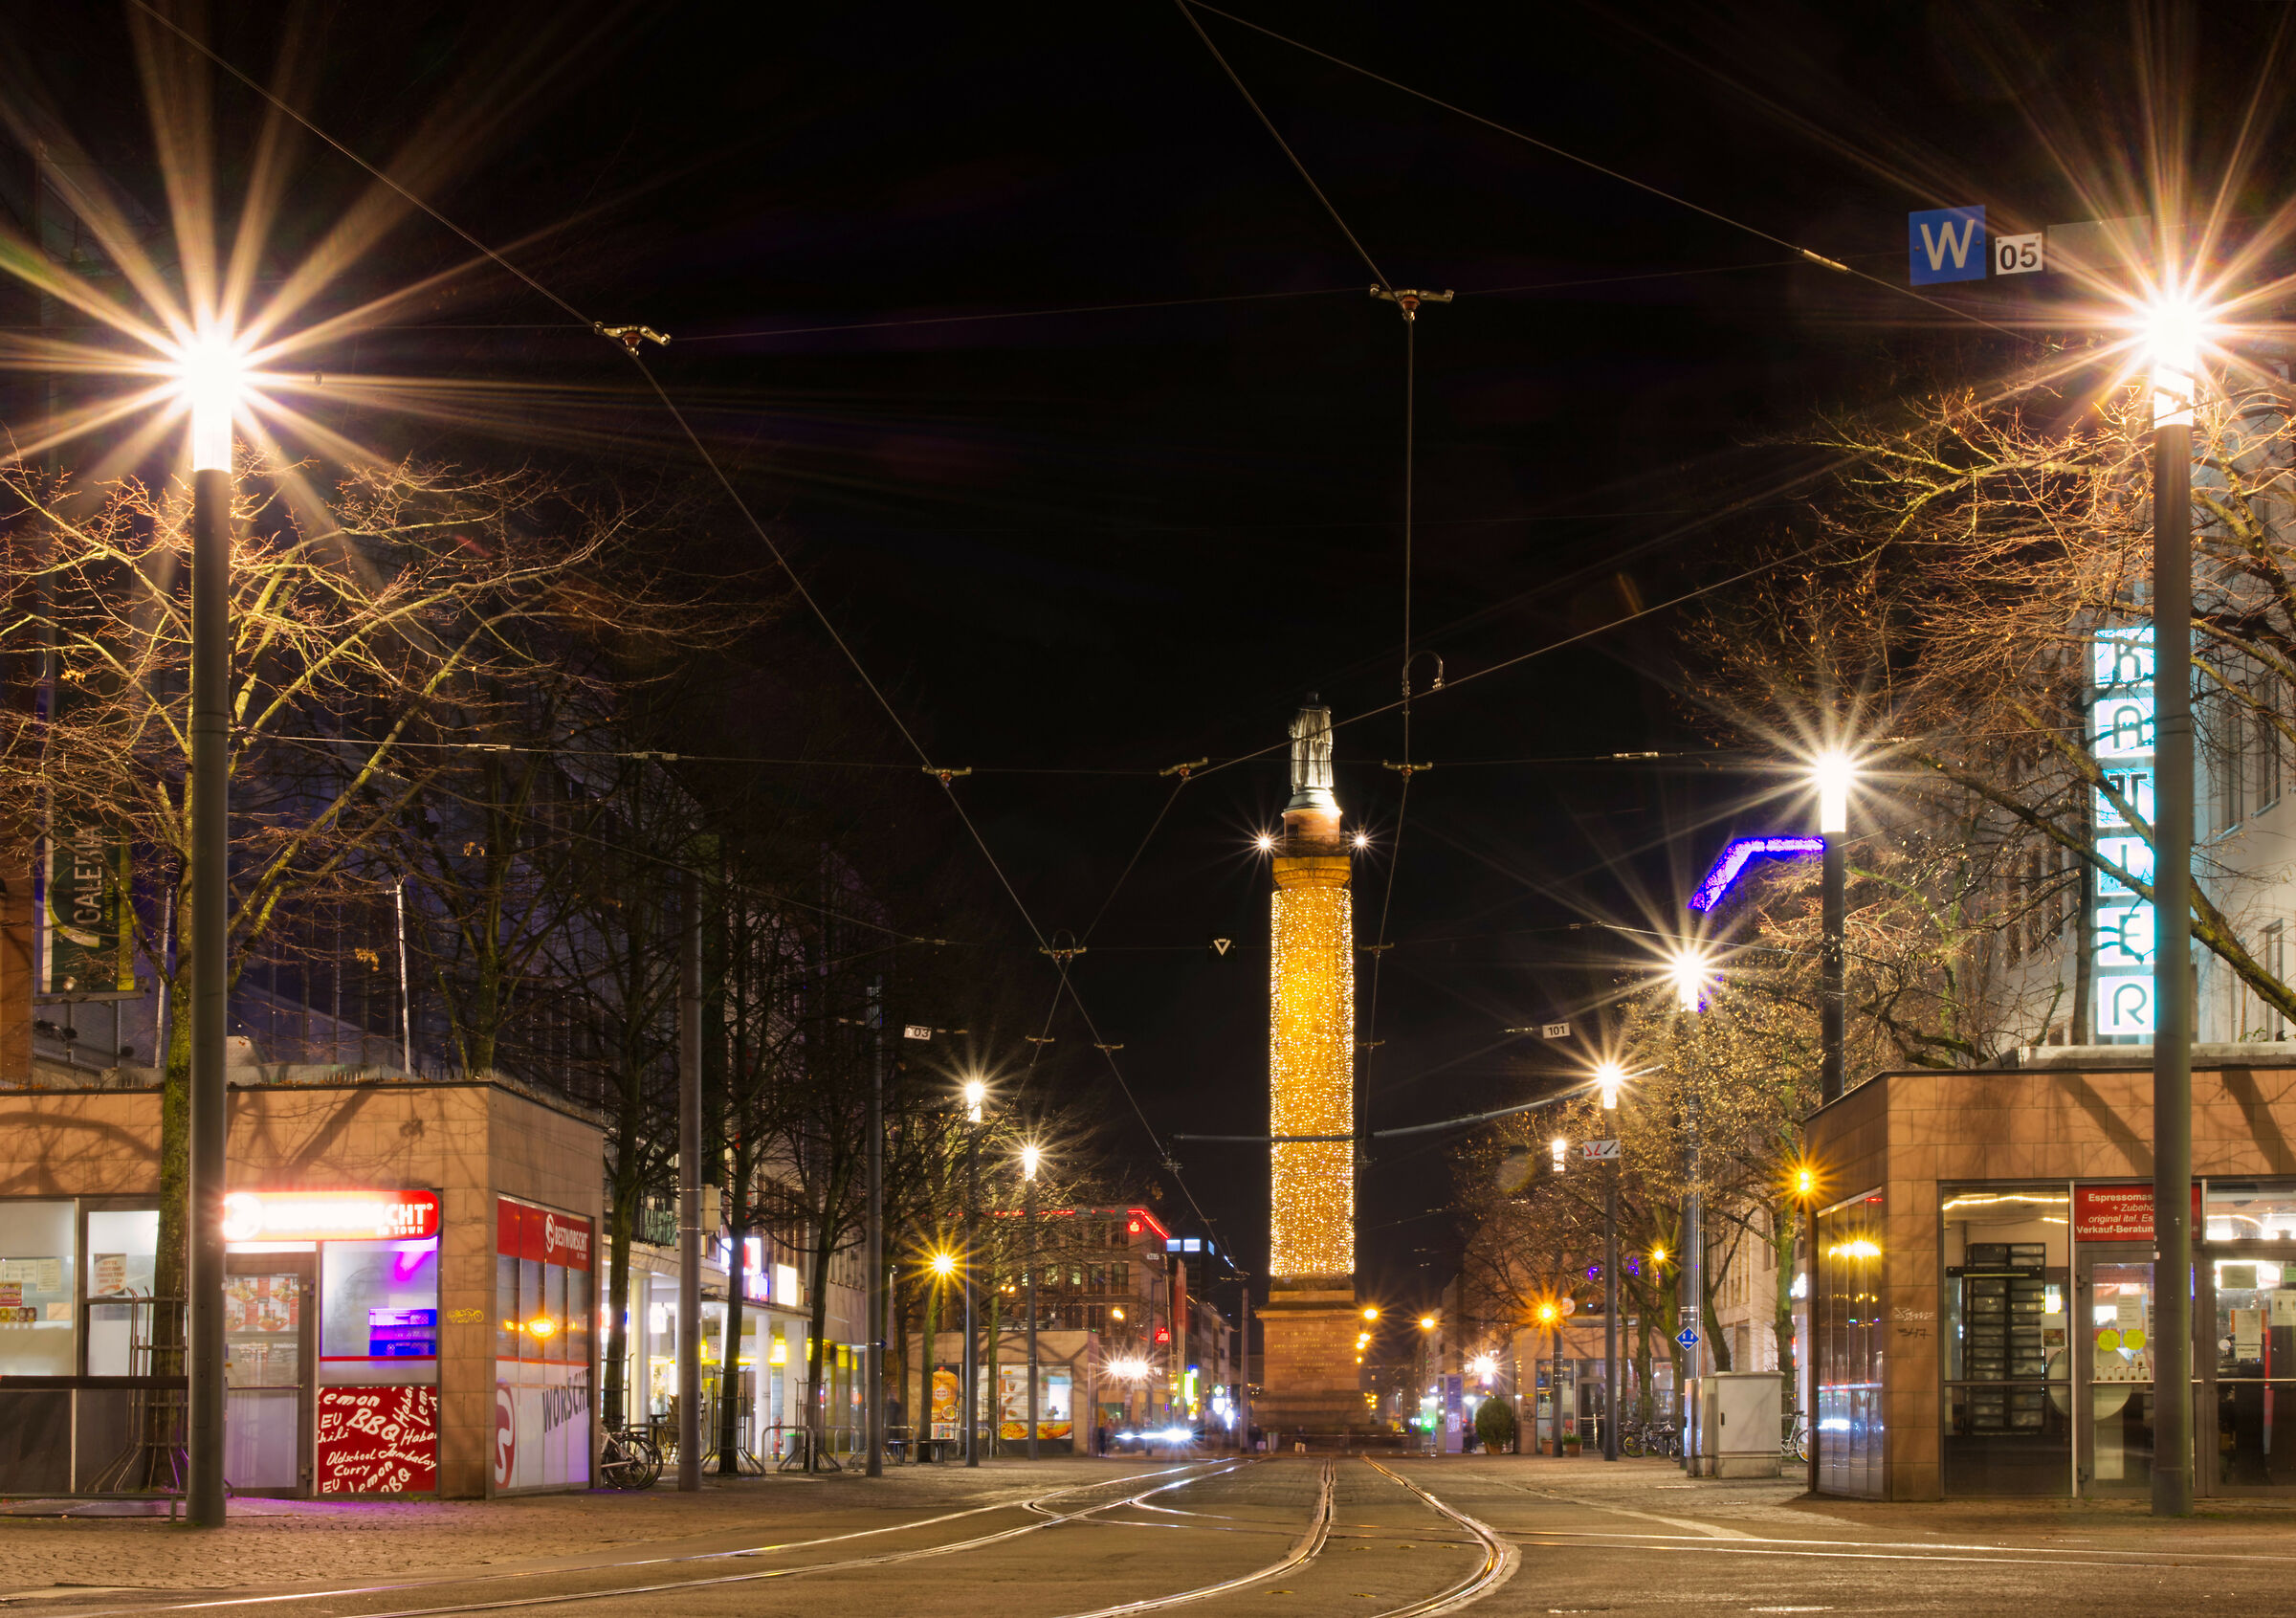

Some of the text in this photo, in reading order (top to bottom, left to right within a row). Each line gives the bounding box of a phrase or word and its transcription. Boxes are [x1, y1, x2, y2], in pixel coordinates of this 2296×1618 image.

[1920, 219, 1975, 271] W
[1999, 242, 2038, 271] 05
[1548, 1025, 1565, 1036] 101
[2088, 1214, 2122, 1225] original
[394, 1226, 424, 1234] TOWN
[392, 1386, 413, 1428] Haba
[320, 1411, 342, 1430] EU
[345, 1407, 401, 1442] BBQ
[318, 1425, 350, 1444] hili
[326, 1448, 377, 1466] Oldschool
[333, 1464, 371, 1477] Curry
[322, 1478, 341, 1493] EU
